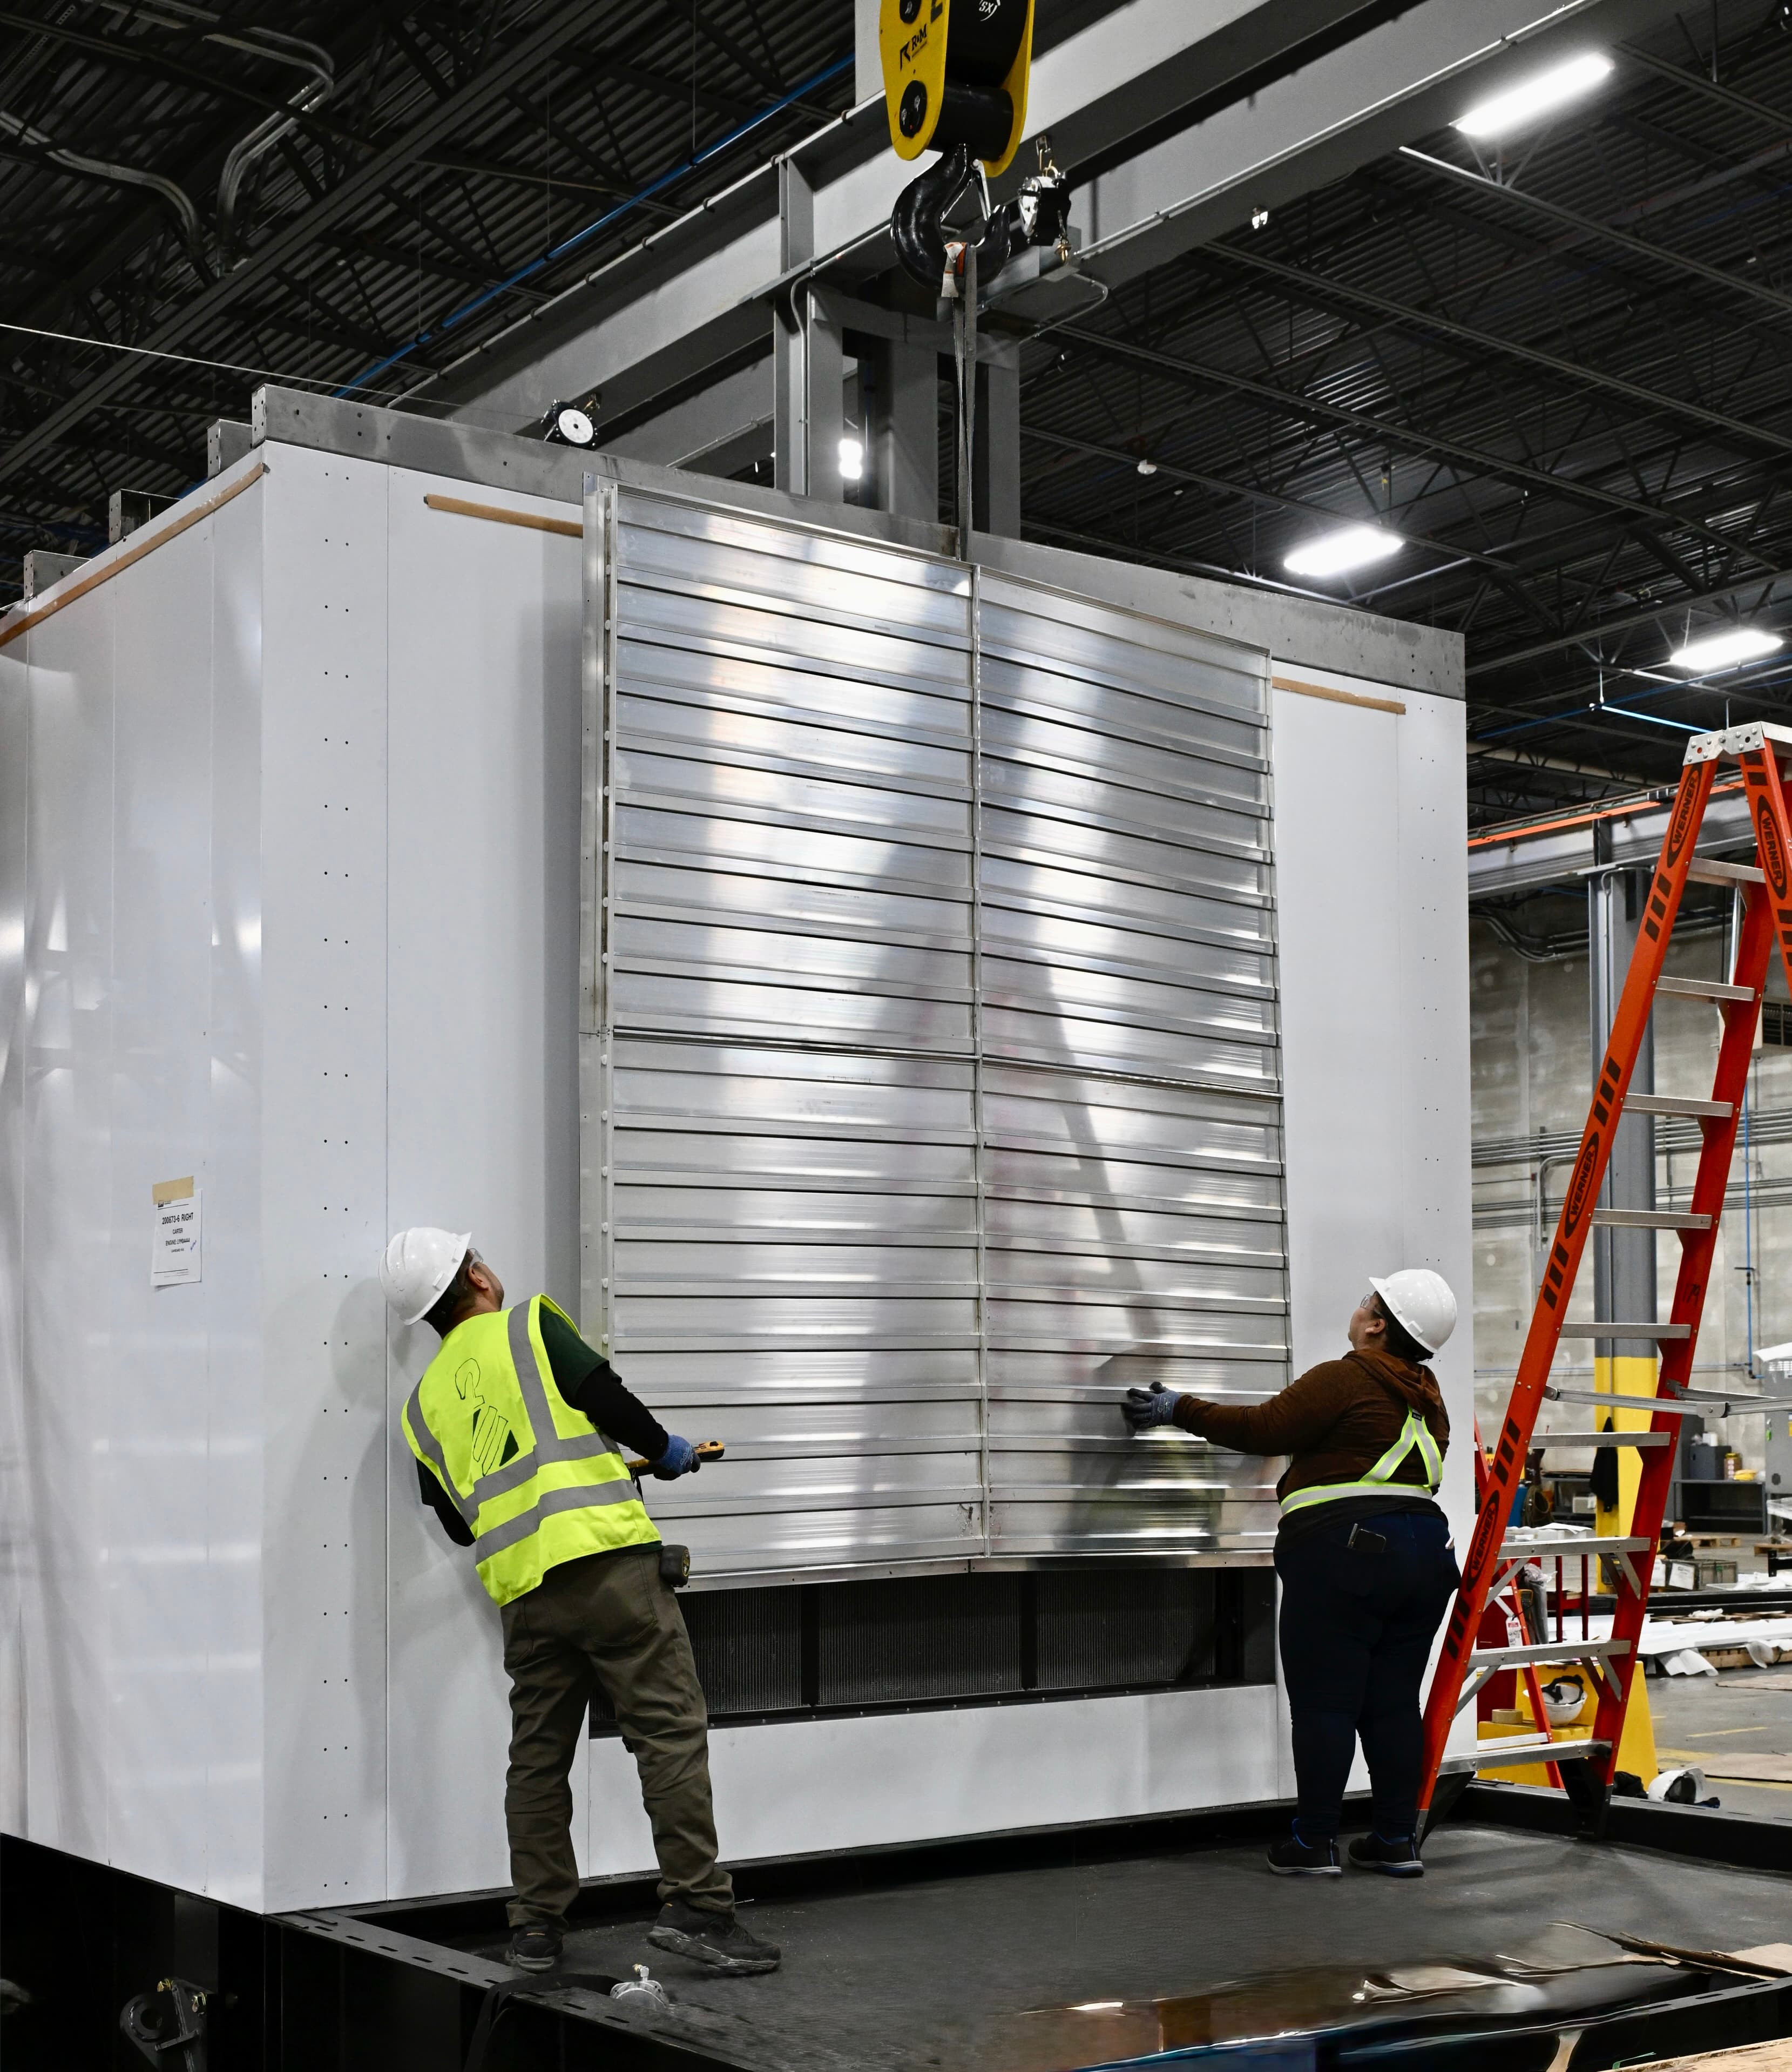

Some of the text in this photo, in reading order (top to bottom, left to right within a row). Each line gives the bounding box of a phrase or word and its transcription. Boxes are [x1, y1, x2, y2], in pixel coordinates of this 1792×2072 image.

[979, 1, 994, 14] SX
[1672, 777, 1695, 844] WERNER
[1762, 817, 1782, 880] WERNER
[1570, 1151, 1594, 1215] WERNER
[181, 1212, 193, 1221] RIGHT
[1472, 1507, 1495, 1571] WERNER
